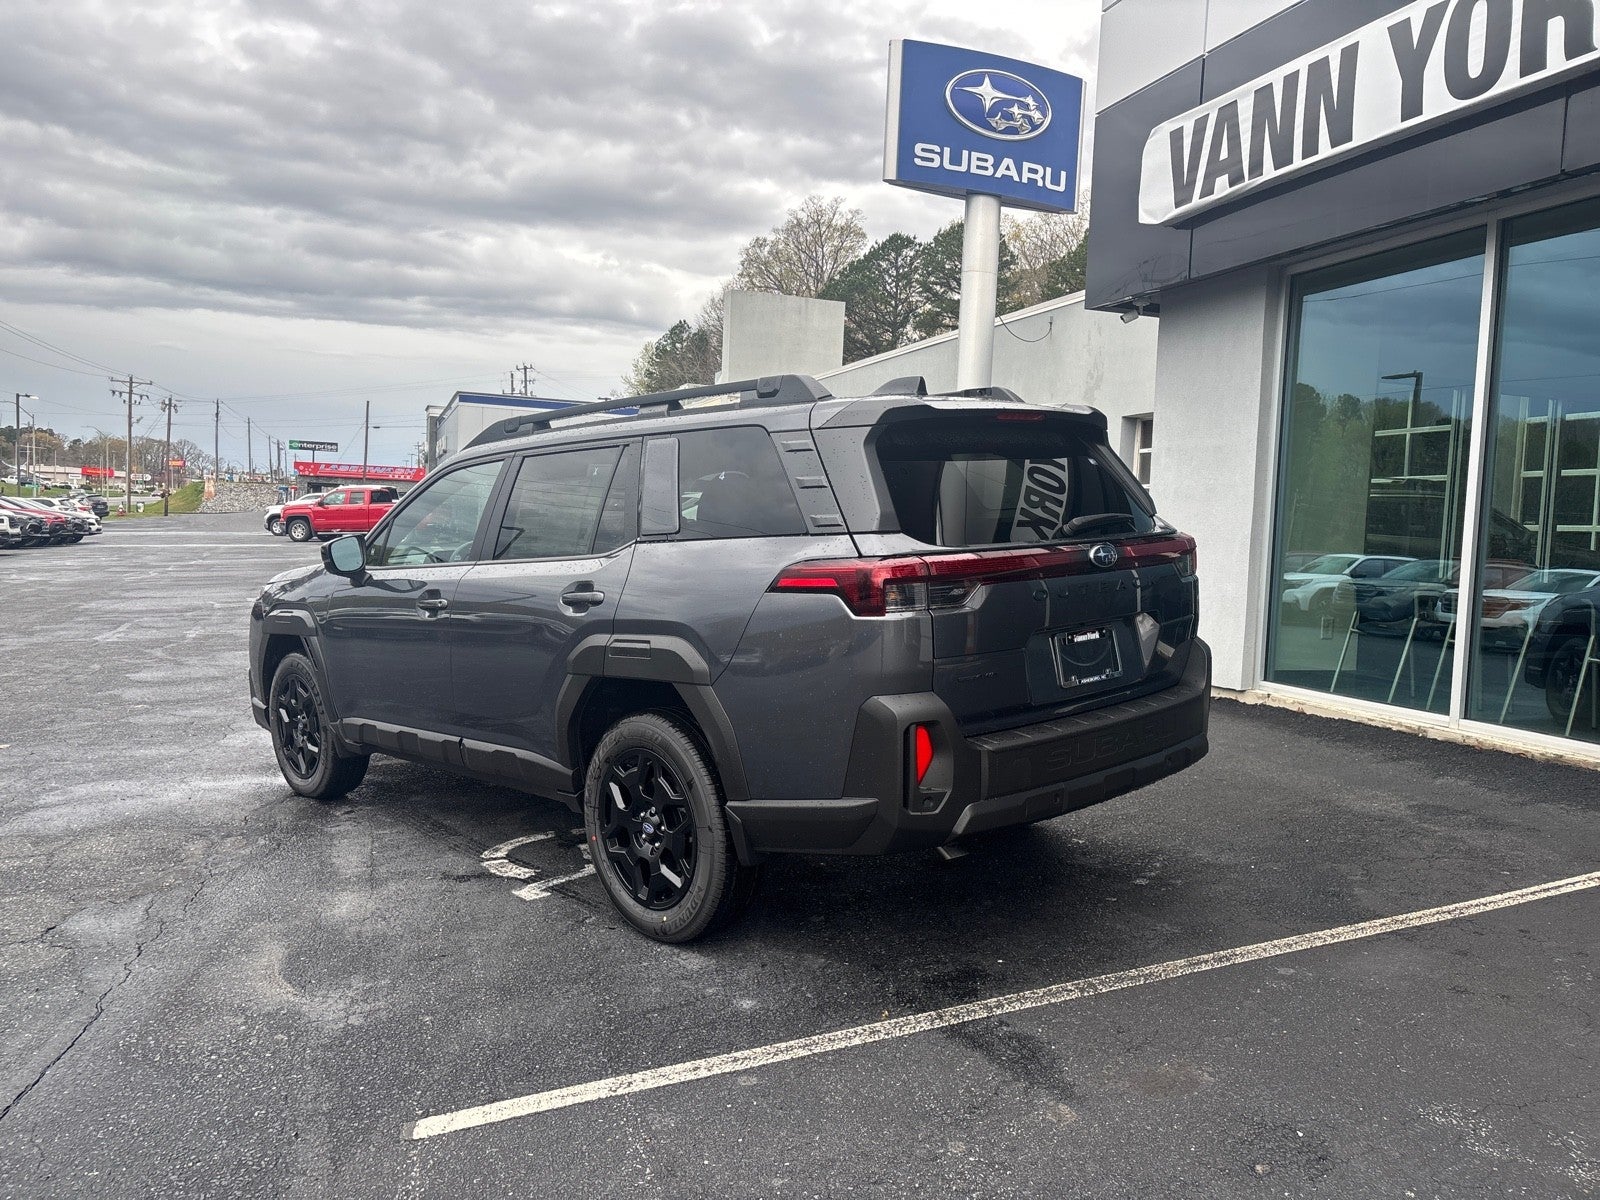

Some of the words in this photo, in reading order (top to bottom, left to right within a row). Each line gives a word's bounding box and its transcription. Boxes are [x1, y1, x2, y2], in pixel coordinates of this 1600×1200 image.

[1169, 40, 1360, 209] VANN
[913, 142, 1067, 192] SUBARU
[290, 441, 338, 451] enterprise
